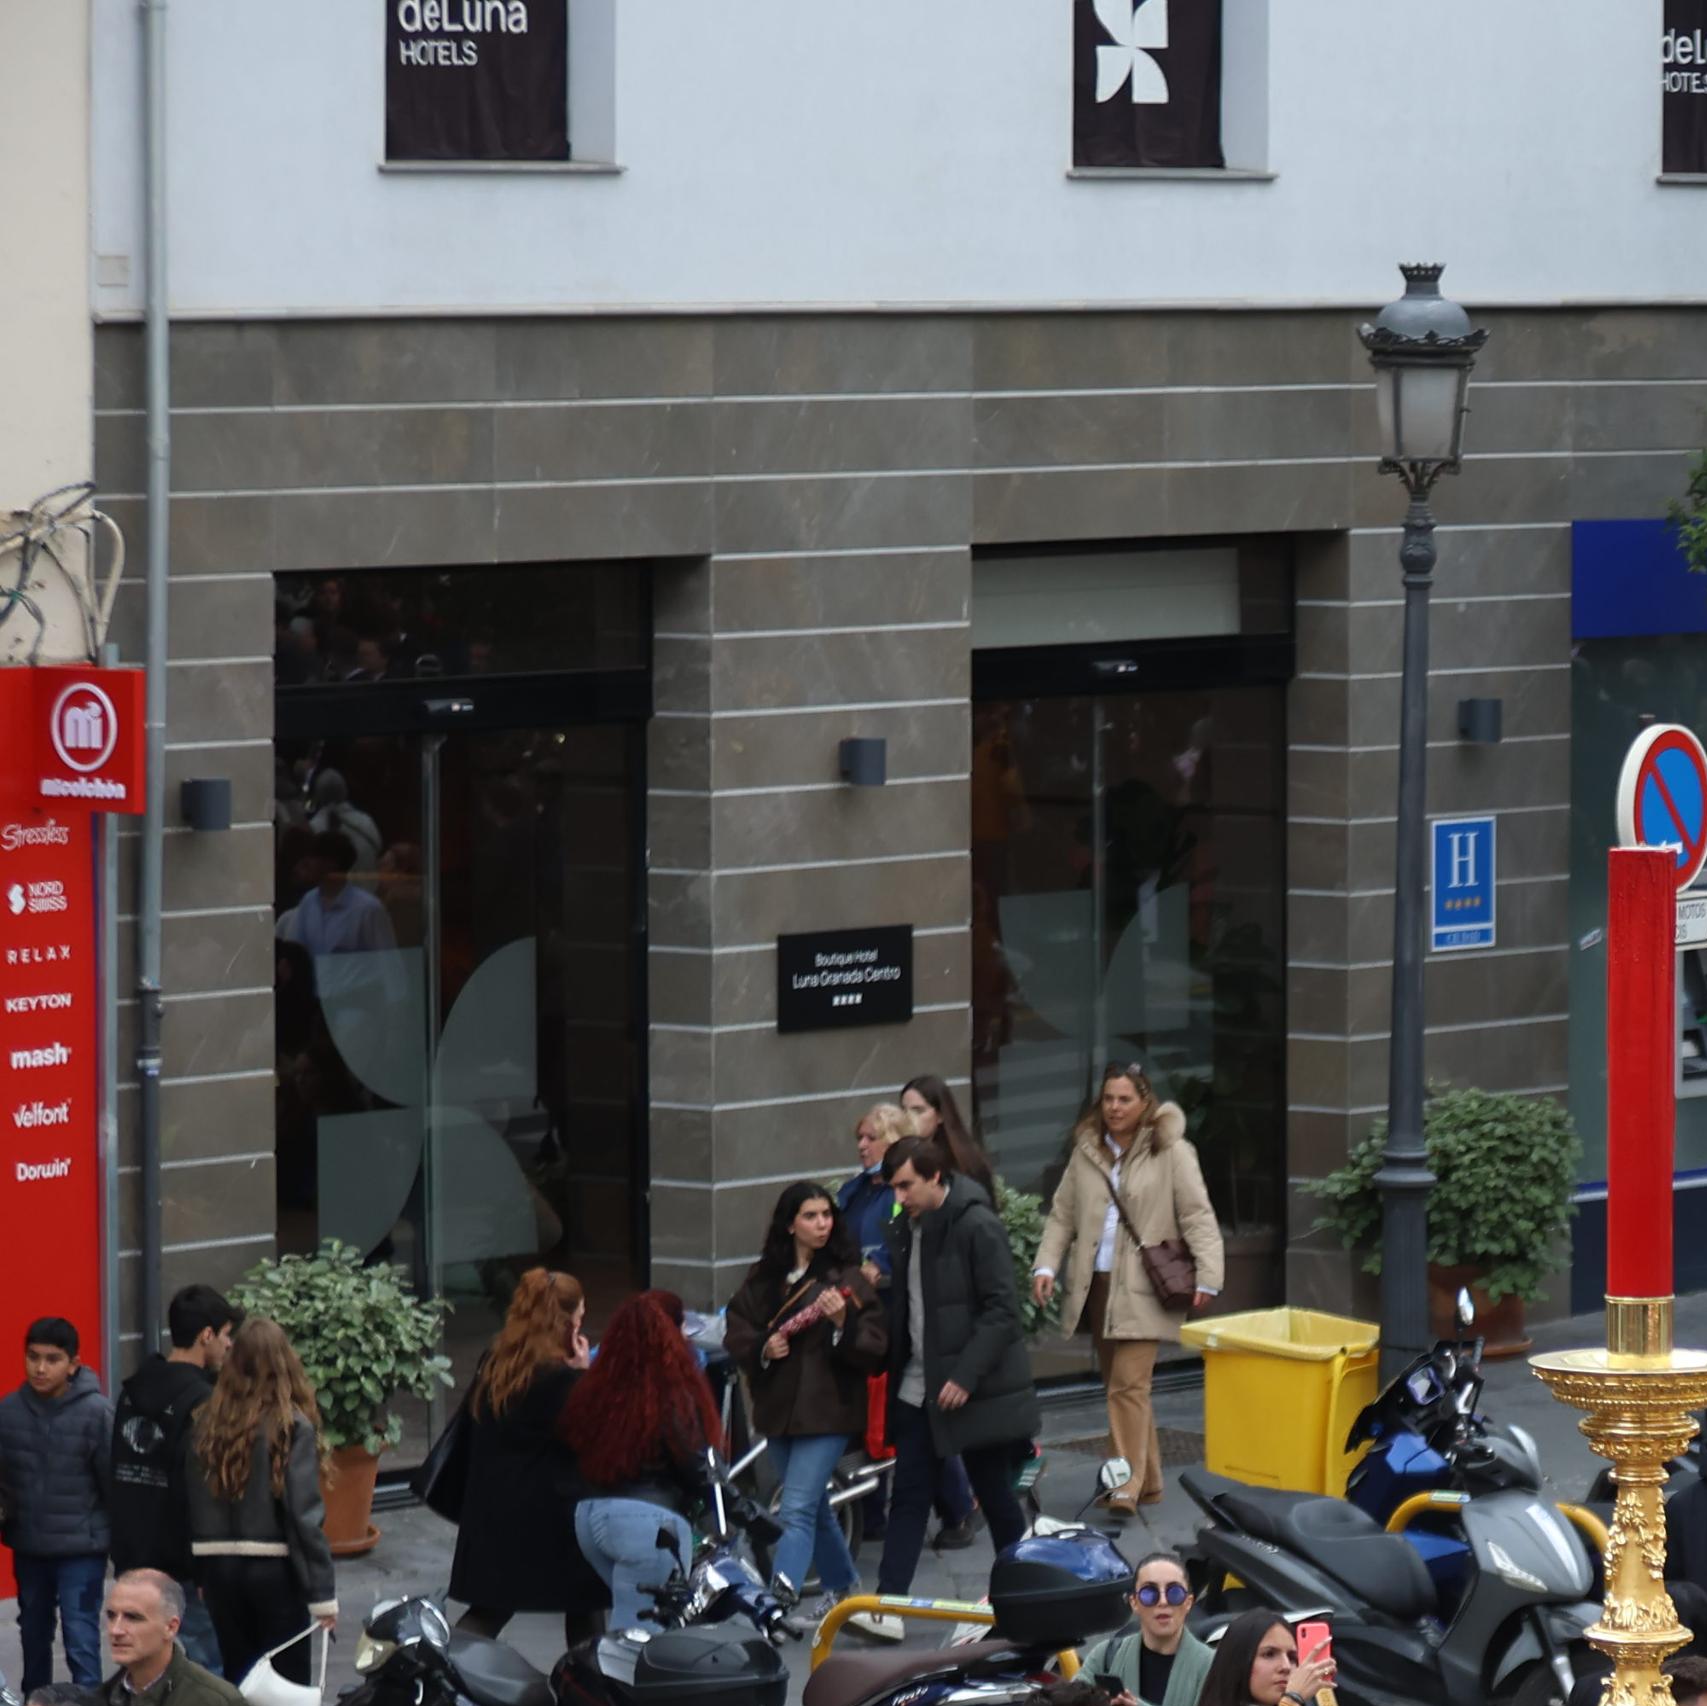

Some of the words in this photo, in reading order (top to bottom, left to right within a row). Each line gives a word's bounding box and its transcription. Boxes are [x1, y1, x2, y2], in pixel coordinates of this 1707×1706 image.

[398, 0, 528, 33] deLuna
[399, 39, 478, 66] HOTELS
[1448, 831, 1480, 888] H
[6, 944, 71, 965] RELAX
[792, 973, 819, 989] Luna
[820, 970, 863, 987] Granada
[864, 966, 901, 982] Centro
[6, 993, 73, 1012] KEYTON
